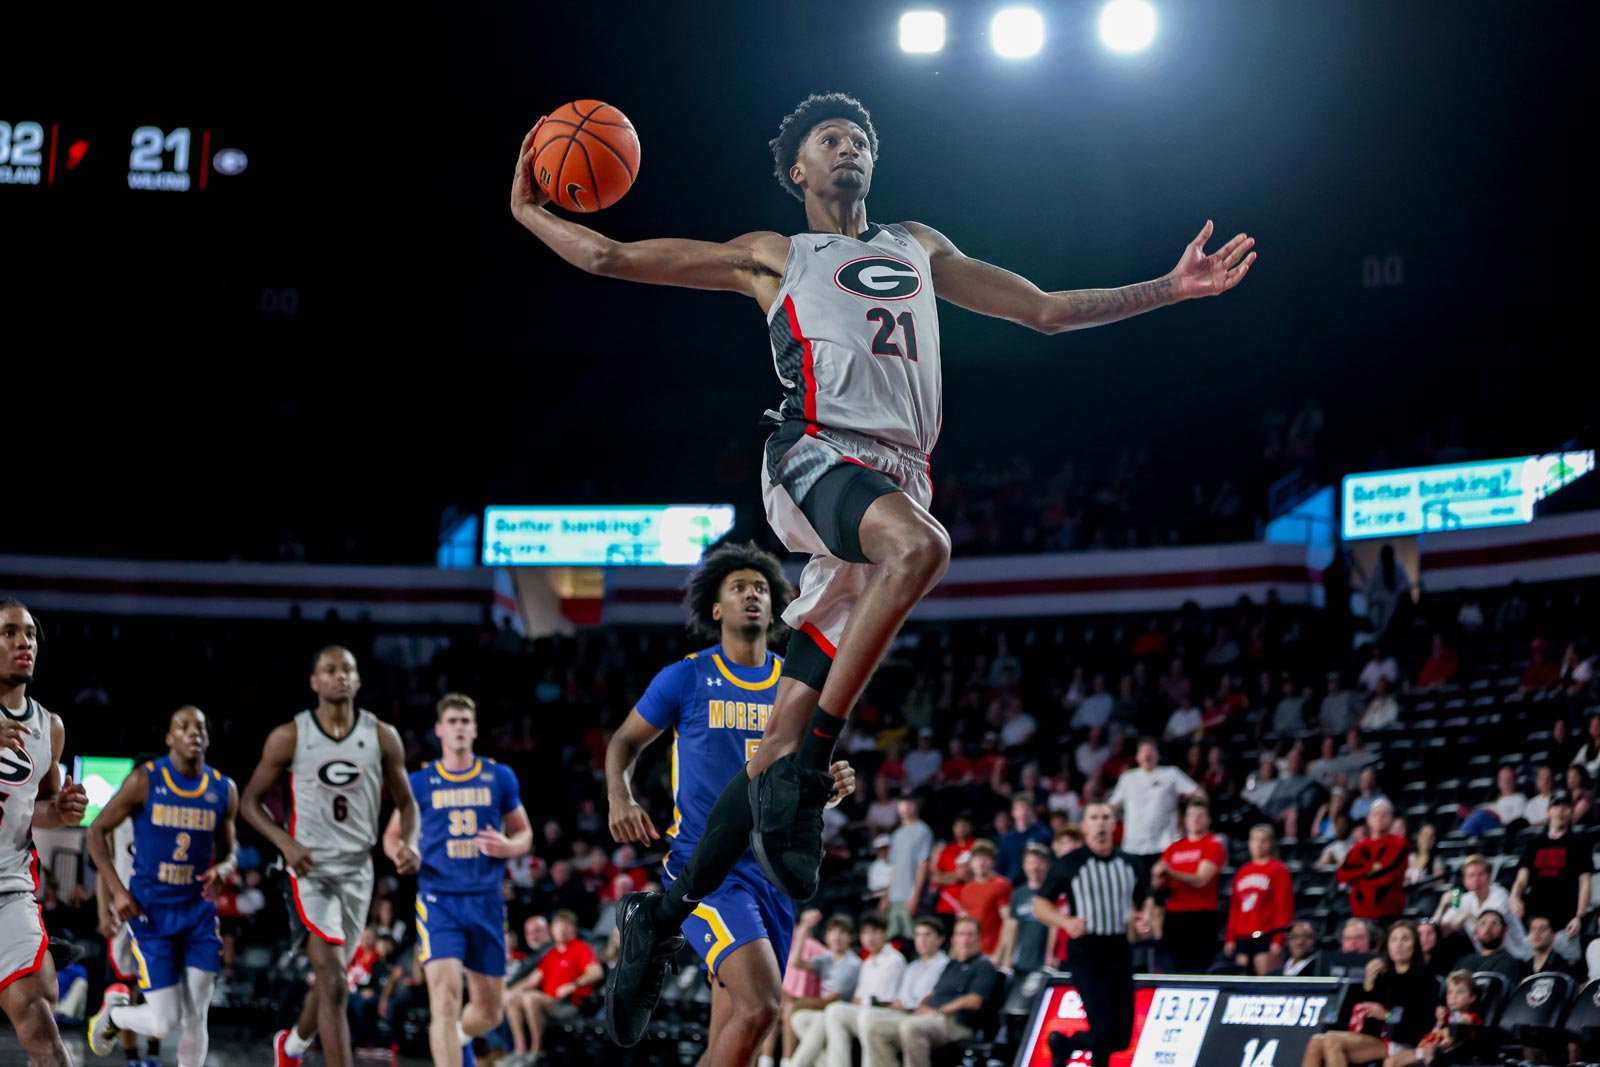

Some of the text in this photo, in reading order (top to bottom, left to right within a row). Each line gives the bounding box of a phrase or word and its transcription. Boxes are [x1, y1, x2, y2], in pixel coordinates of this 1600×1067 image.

[130, 126, 190, 171] 21
[835, 256, 922, 300] G
[866, 307, 918, 362] 21
[709, 700, 773, 731] MOREH
[314, 759, 363, 791] G
[151, 803, 216, 832] MOREHEAD
[333, 794, 348, 822] 6
[448, 809, 477, 836] 33
[172, 832, 191, 861] 2
[1155, 996, 1210, 1022] 13:17
